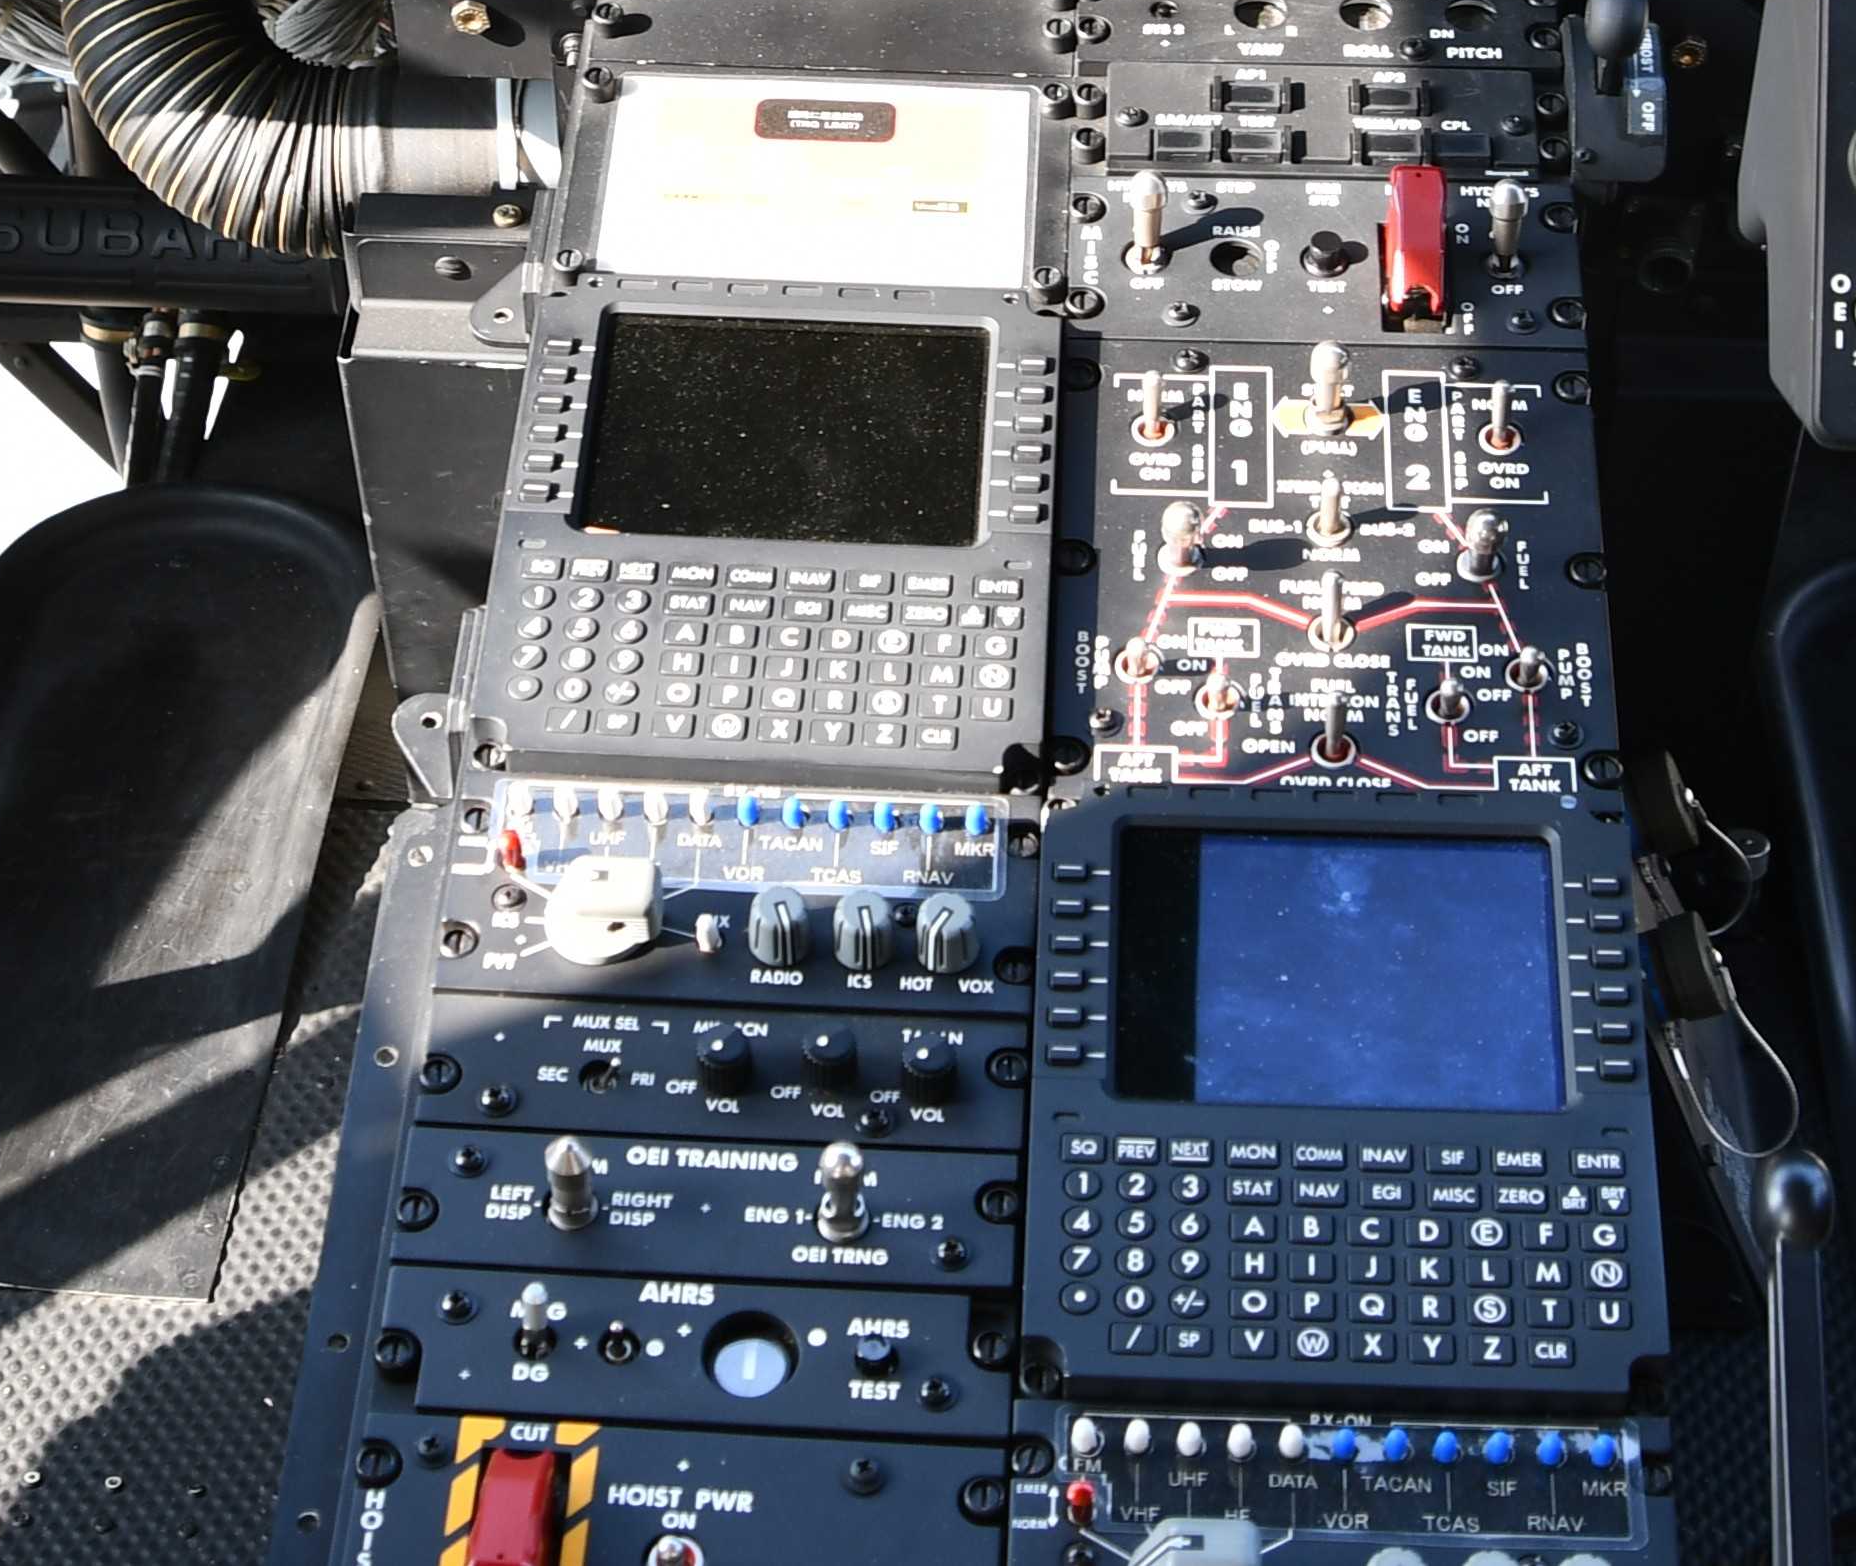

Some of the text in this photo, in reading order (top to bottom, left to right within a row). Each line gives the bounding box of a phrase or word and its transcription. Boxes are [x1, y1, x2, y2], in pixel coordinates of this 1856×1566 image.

[1447, 47, 1502, 60] PITCH
[1441, 121, 1471, 132] CPL
[1424, 629, 1467, 642] FWD
[1422, 643, 1471, 658] TANK
[1518, 763, 1552, 777] AFT
[1510, 778, 1561, 794] TANK
[750, 969, 802, 985] RADIO
[847, 974, 872, 989] ICS
[900, 976, 933, 991] HOT
[958, 979, 994, 994] VOX
[572, 1015, 640, 1033] MUX SEL
[584, 1038, 621, 1053] MUX
[626, 1146, 798, 1173] OEI TRAINING
[1231, 1144, 1276, 1160] MON
[1363, 1147, 1407, 1164] INAV
[1496, 1152, 1542, 1168] EMER
[1577, 1154, 1620, 1171] ENTR
[490, 1186, 534, 1202] LEFT
[1300, 1182, 1340, 1199] NAV
[1433, 1187, 1476, 1204] MISC
[612, 1193, 673, 1210] RIGHT
[486, 1204, 531, 1220] DISP
[609, 1210, 655, 1227] DISP
[792, 1246, 888, 1265] OEI TRNG
[640, 1280, 715, 1306] AHRS
[847, 1318, 910, 1339] AHRS
[512, 1363, 549, 1383] DG
[848, 1380, 901, 1401] TEST
[511, 1424, 550, 1442] CUT
[1268, 1474, 1317, 1489] DATA
[1361, 1476, 1432, 1493] TACAN
[1582, 1482, 1628, 1498] MKR
[608, 1485, 754, 1513] HOIST PWR
[662, 1512, 696, 1531] ON
[1323, 1512, 1369, 1529] VOR
[1423, 1516, 1479, 1533] TCAS
[1527, 1515, 1584, 1532] RNAV
